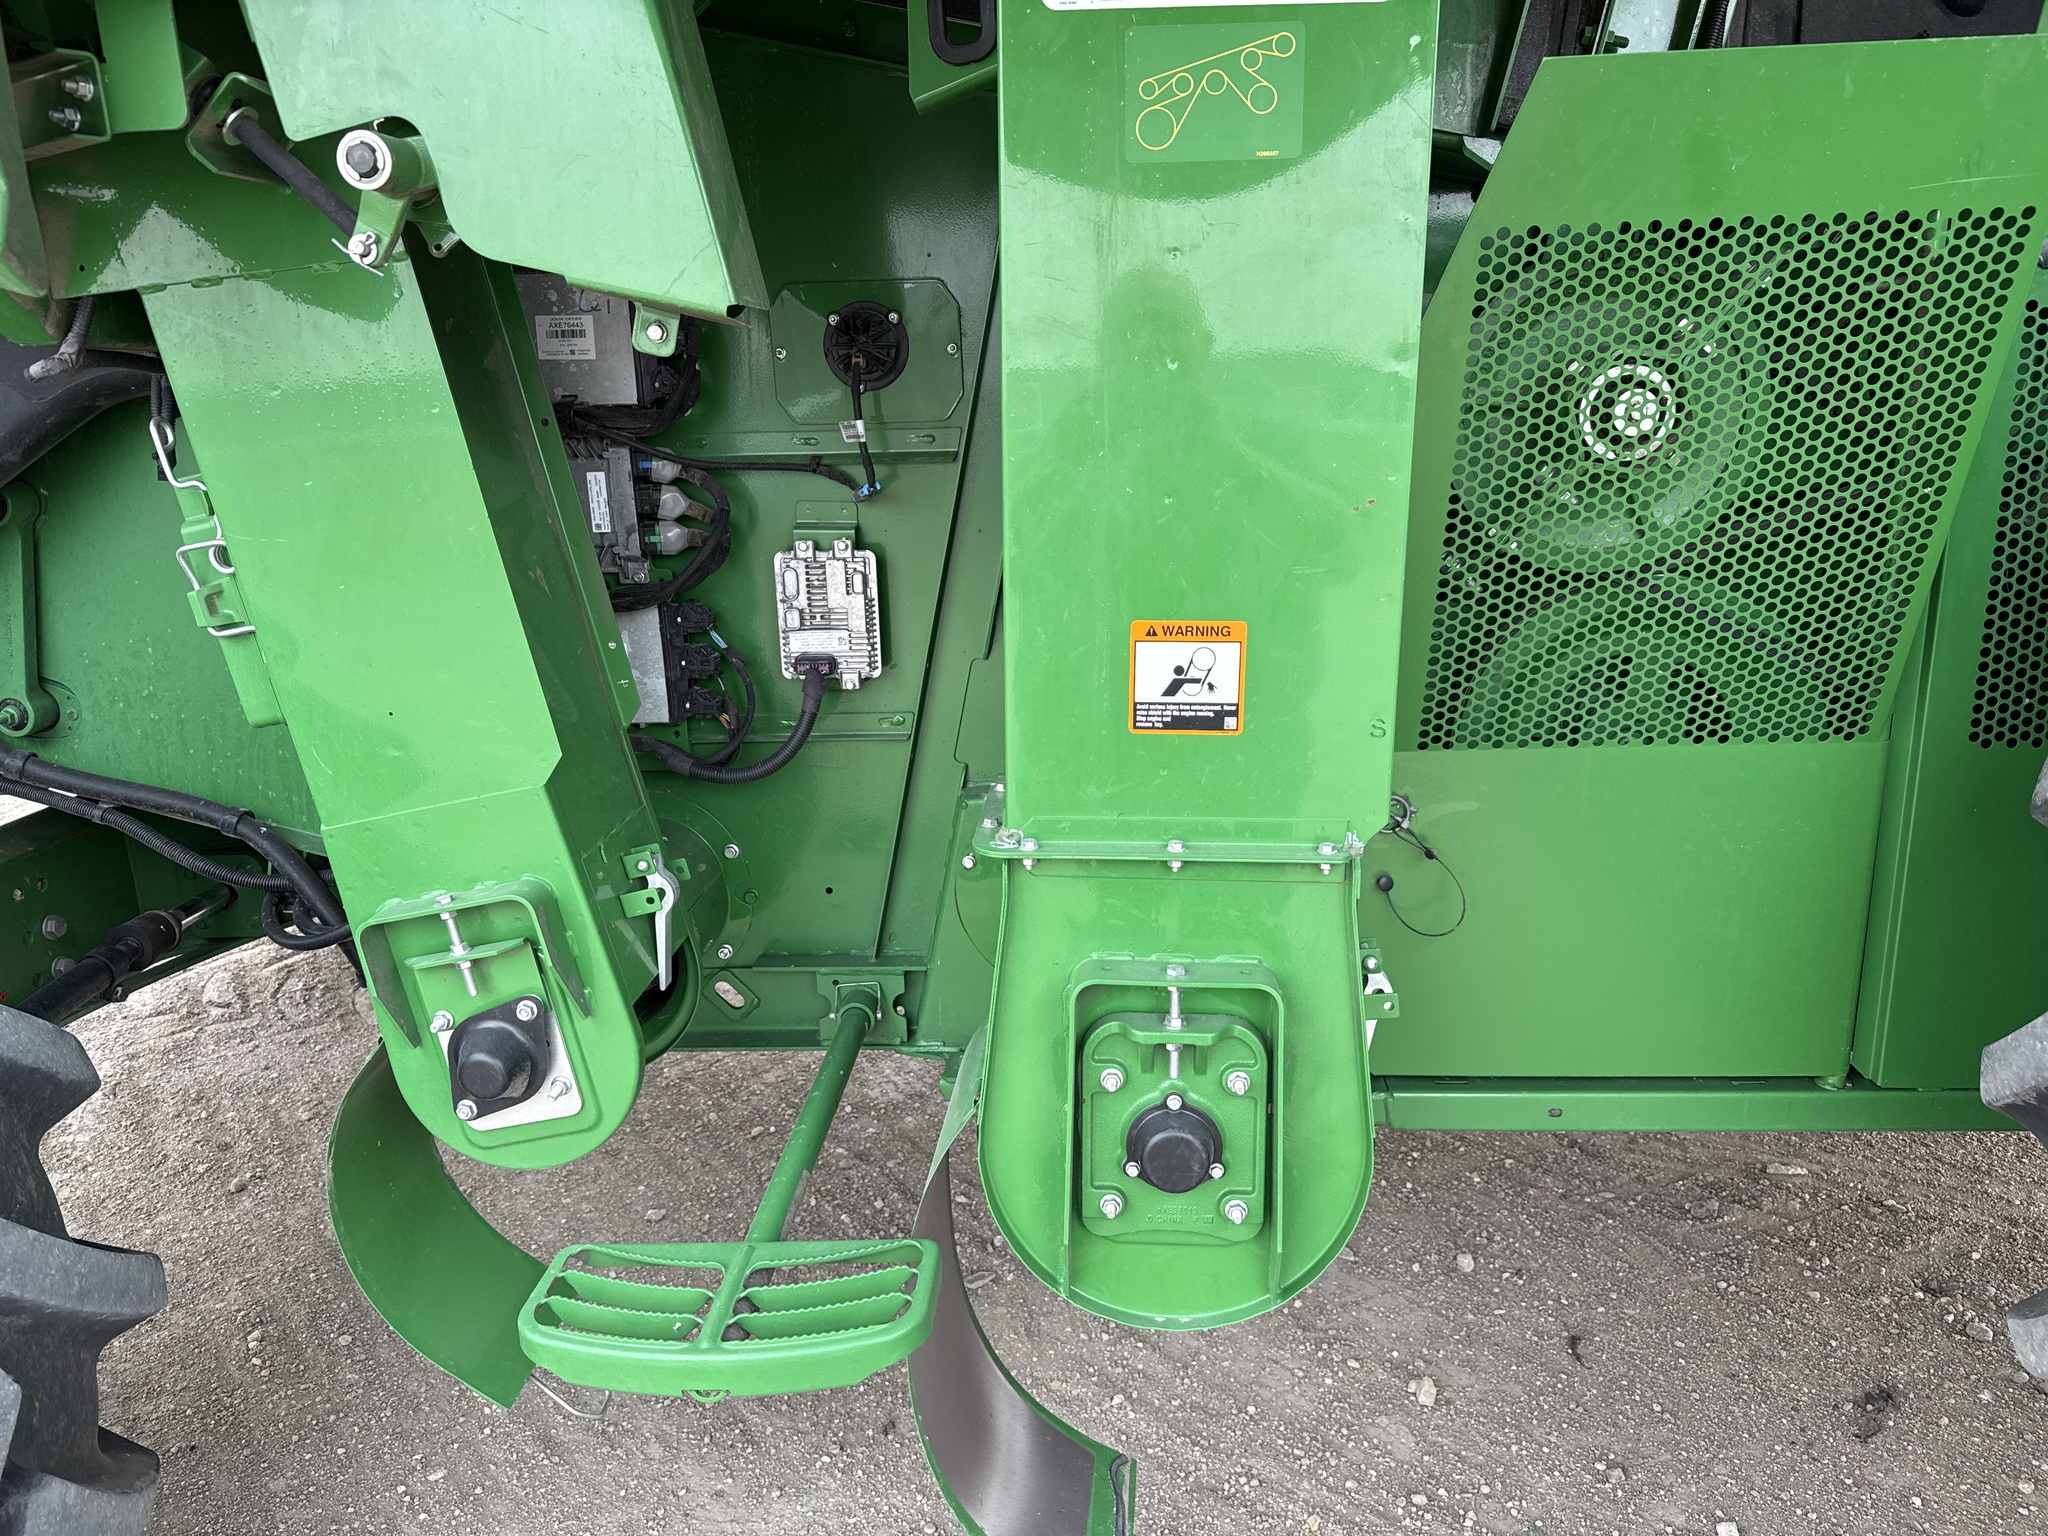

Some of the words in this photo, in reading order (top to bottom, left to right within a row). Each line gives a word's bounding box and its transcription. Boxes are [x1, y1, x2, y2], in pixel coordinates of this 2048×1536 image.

[1162, 626, 1231, 637] WARNING
[1370, 718, 1386, 739] S
[1157, 1215, 1184, 1224] CHINA
